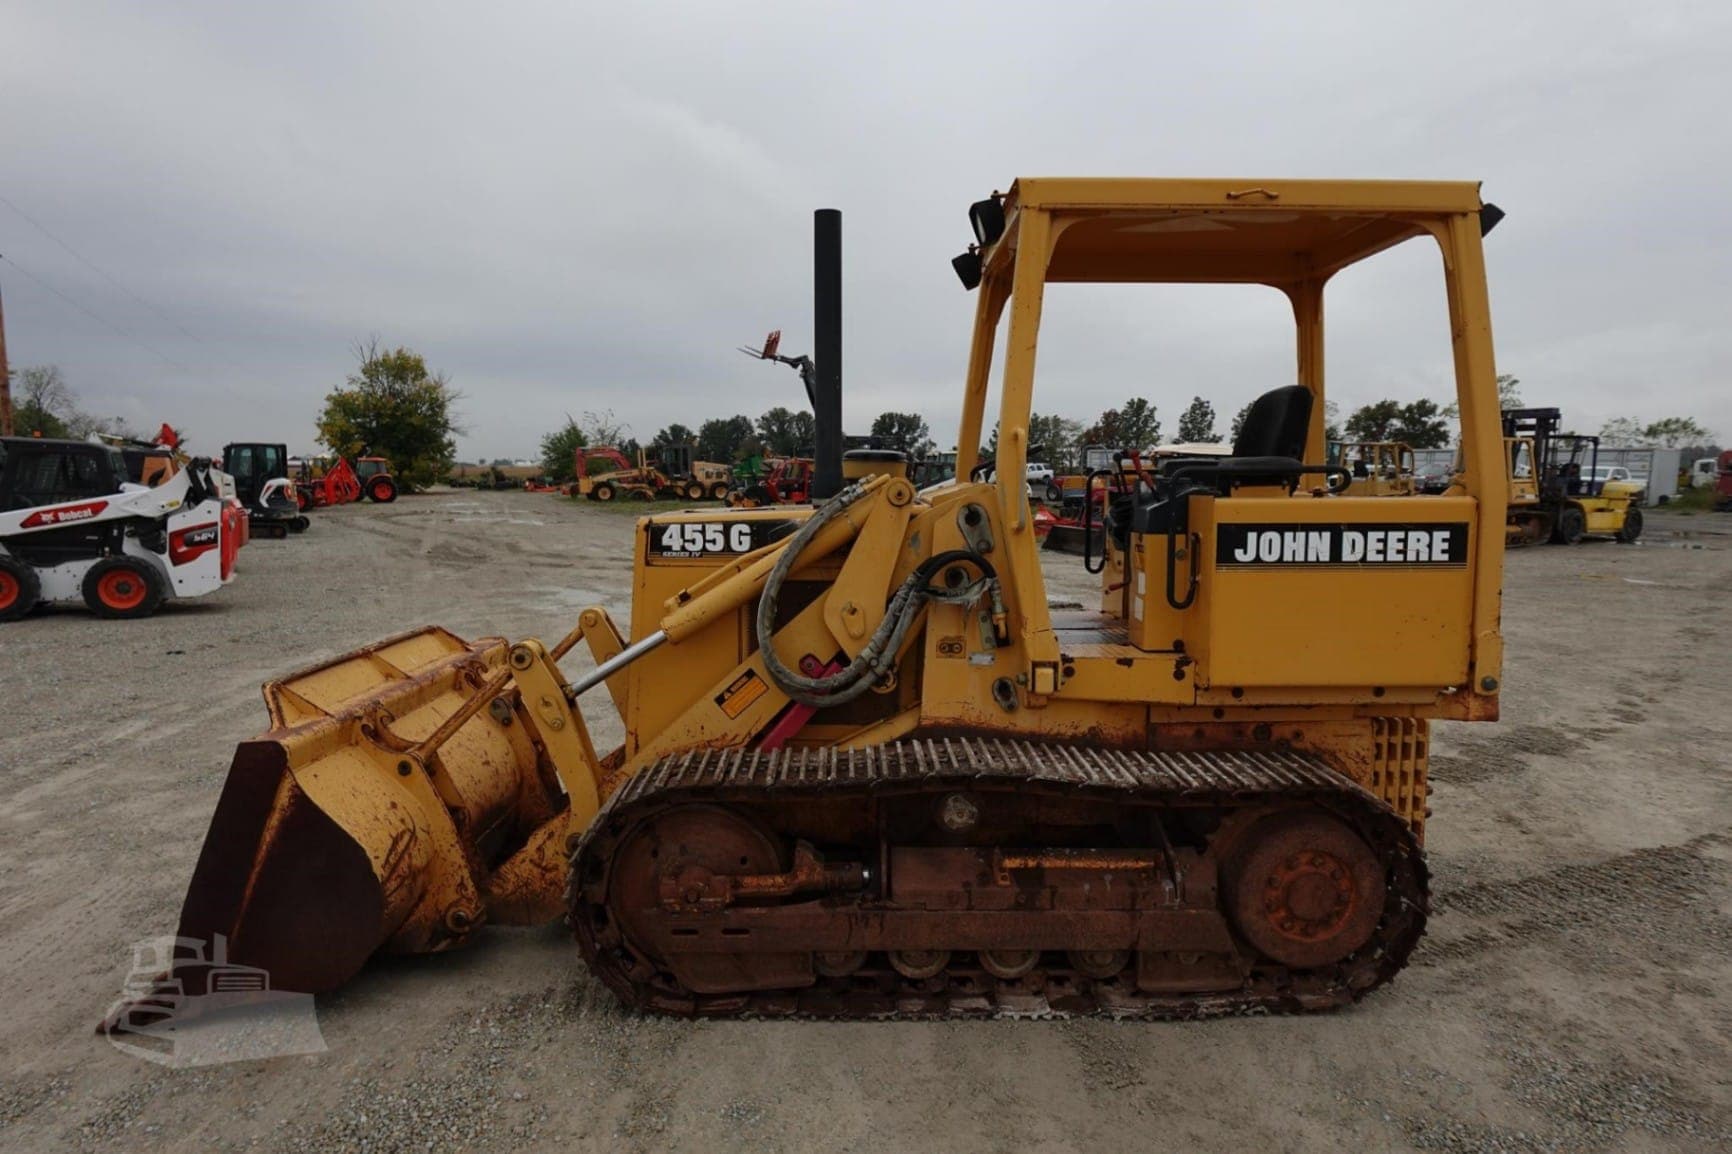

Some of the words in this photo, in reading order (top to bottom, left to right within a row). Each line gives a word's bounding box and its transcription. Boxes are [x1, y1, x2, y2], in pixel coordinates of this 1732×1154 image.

[58, 508, 93, 521] Bobcat
[1234, 531, 1331, 562] JOHN
[1341, 531, 1450, 562] DEERE
